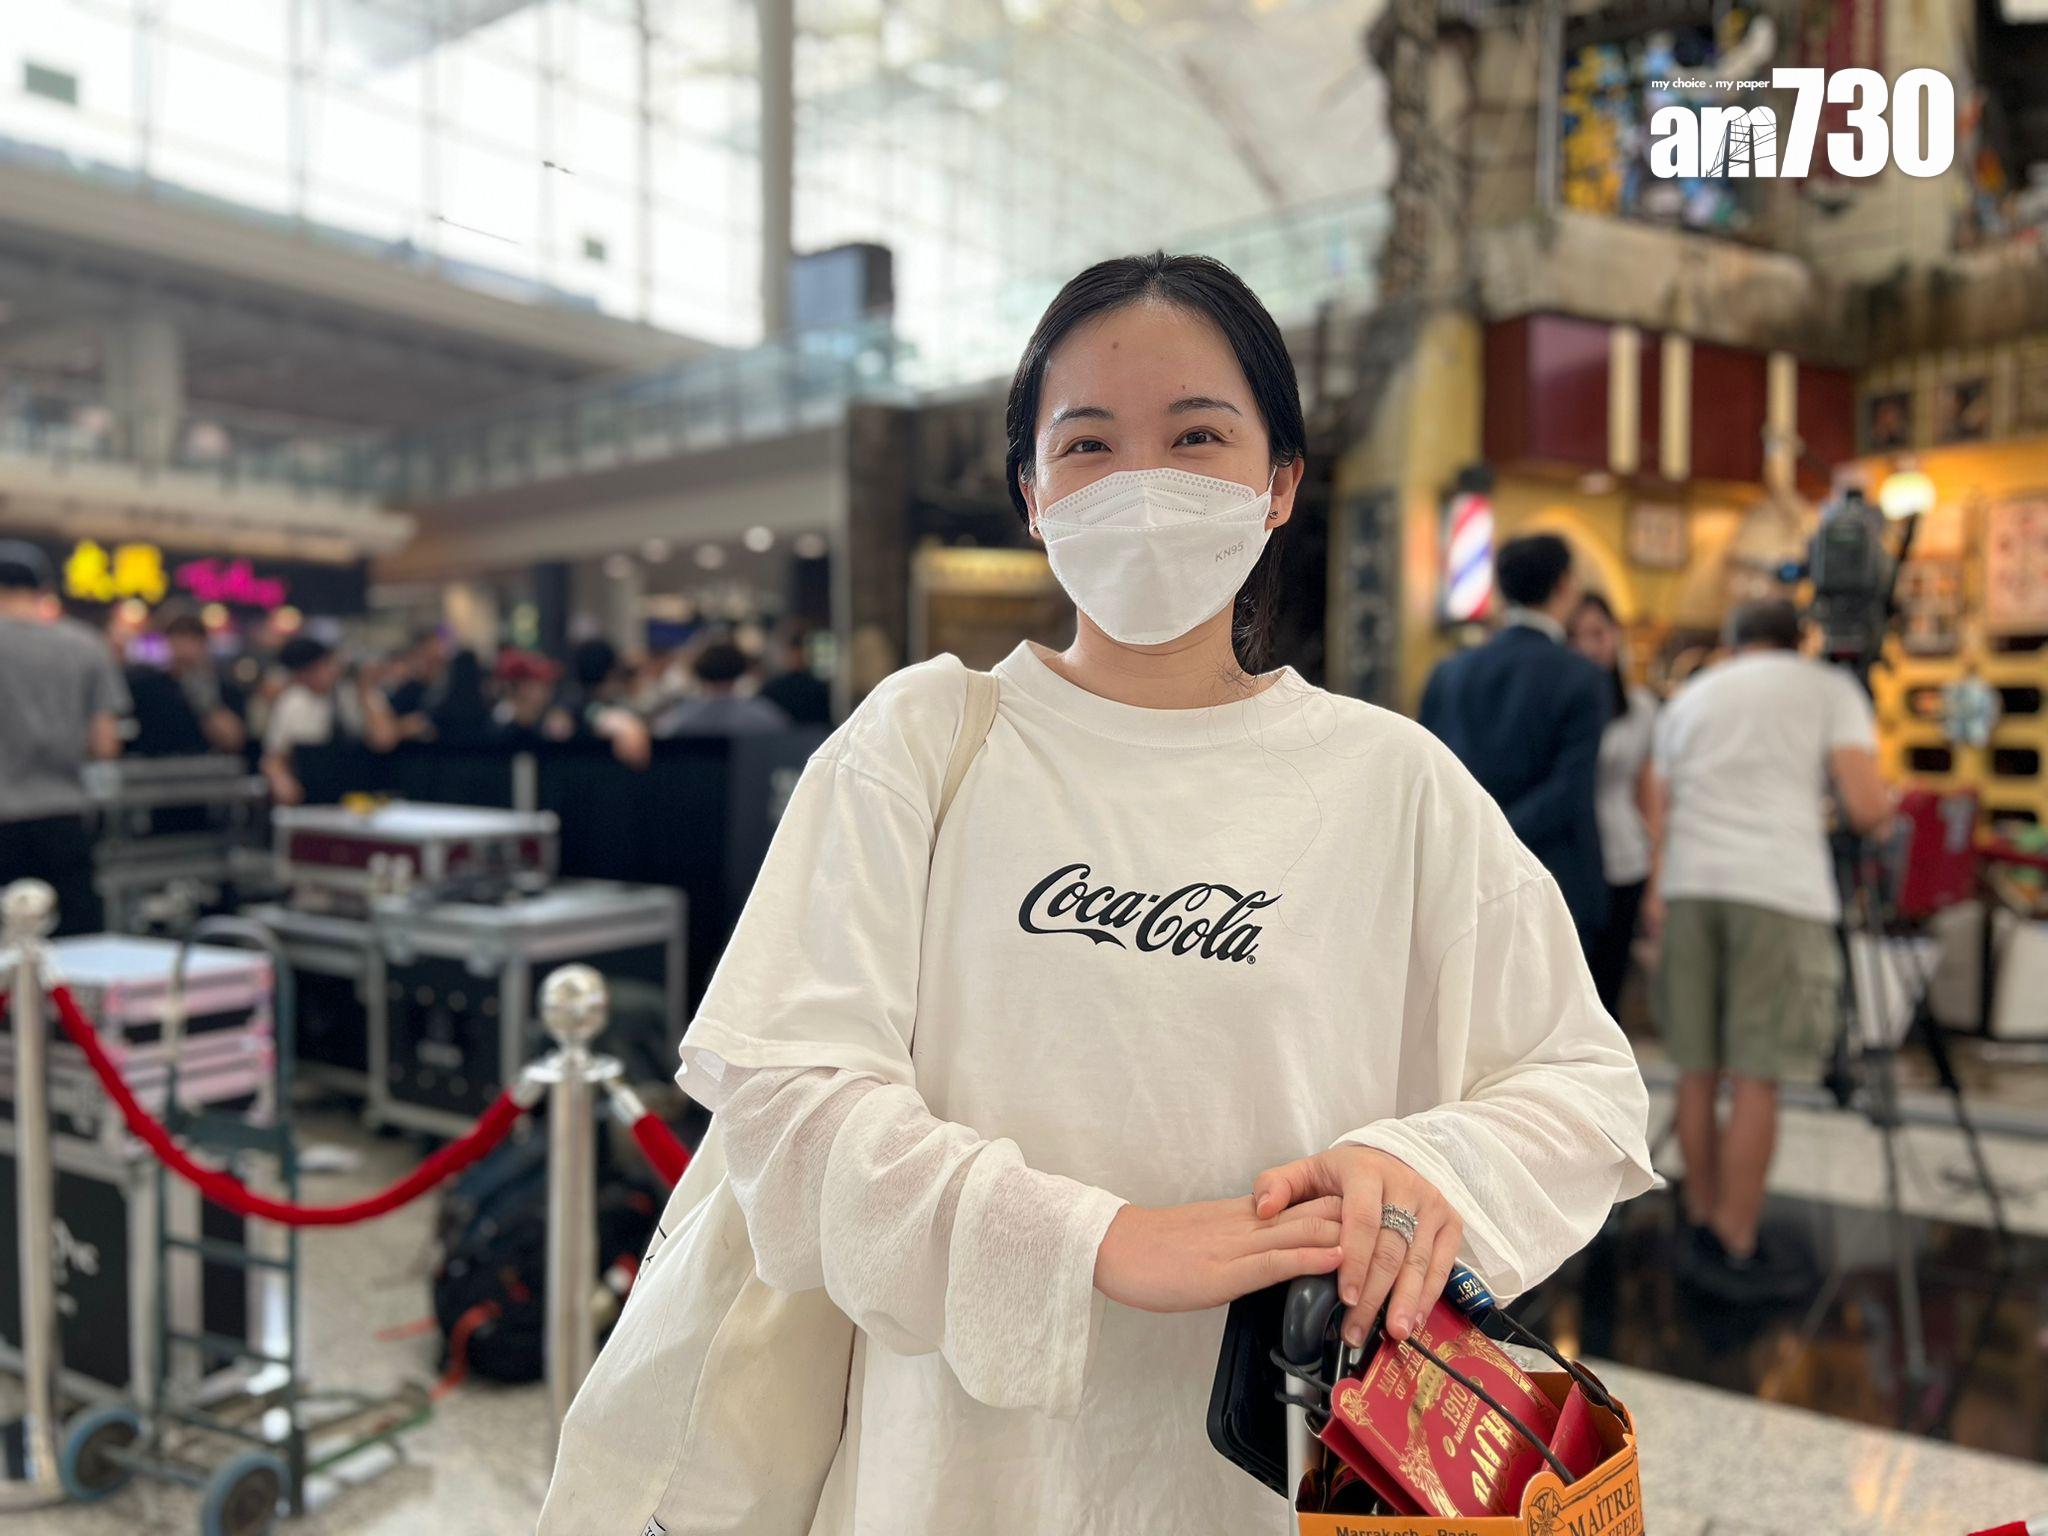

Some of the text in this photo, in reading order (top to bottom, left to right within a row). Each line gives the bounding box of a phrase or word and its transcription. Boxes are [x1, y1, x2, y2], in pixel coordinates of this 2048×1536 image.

[1215, 541, 1244, 562] KN95
[1018, 863, 1283, 963] Coca-Cola
[1409, 1330, 1433, 1370] MAERS
[1440, 1382, 1468, 1426] 1910
[1454, 1393, 1480, 1444] MARRAKECH
